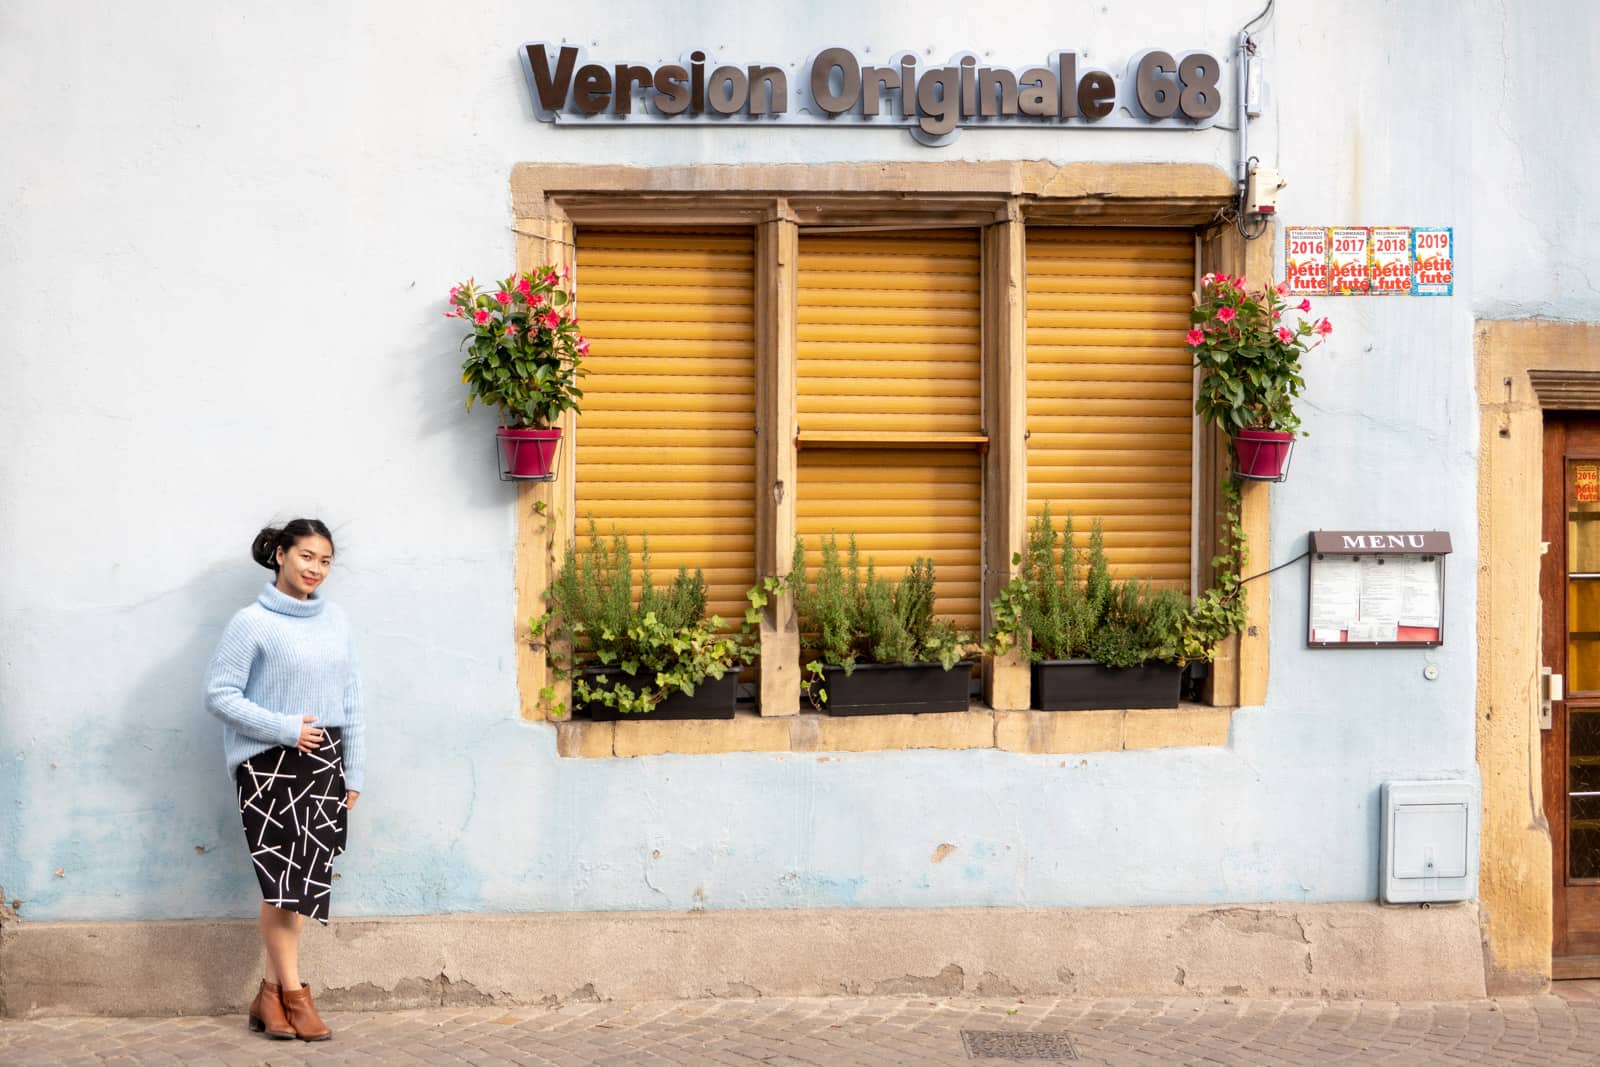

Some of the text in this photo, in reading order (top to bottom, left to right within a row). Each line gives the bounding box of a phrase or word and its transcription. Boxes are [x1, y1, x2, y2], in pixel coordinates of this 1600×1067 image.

[525, 43, 1222, 136] Version Originale 68
[1291, 241, 1324, 255] 2016
[1335, 239, 1365, 252] 2017
[1376, 239, 1407, 252] 2018
[1417, 233, 1448, 249] 2019
[1287, 263, 1327, 279] petit
[1330, 264, 1369, 281] petit
[1372, 264, 1411, 280] petit
[1413, 258, 1452, 275] petit
[1578, 472, 1596, 480] 2016
[1342, 535, 1425, 549] MENU
